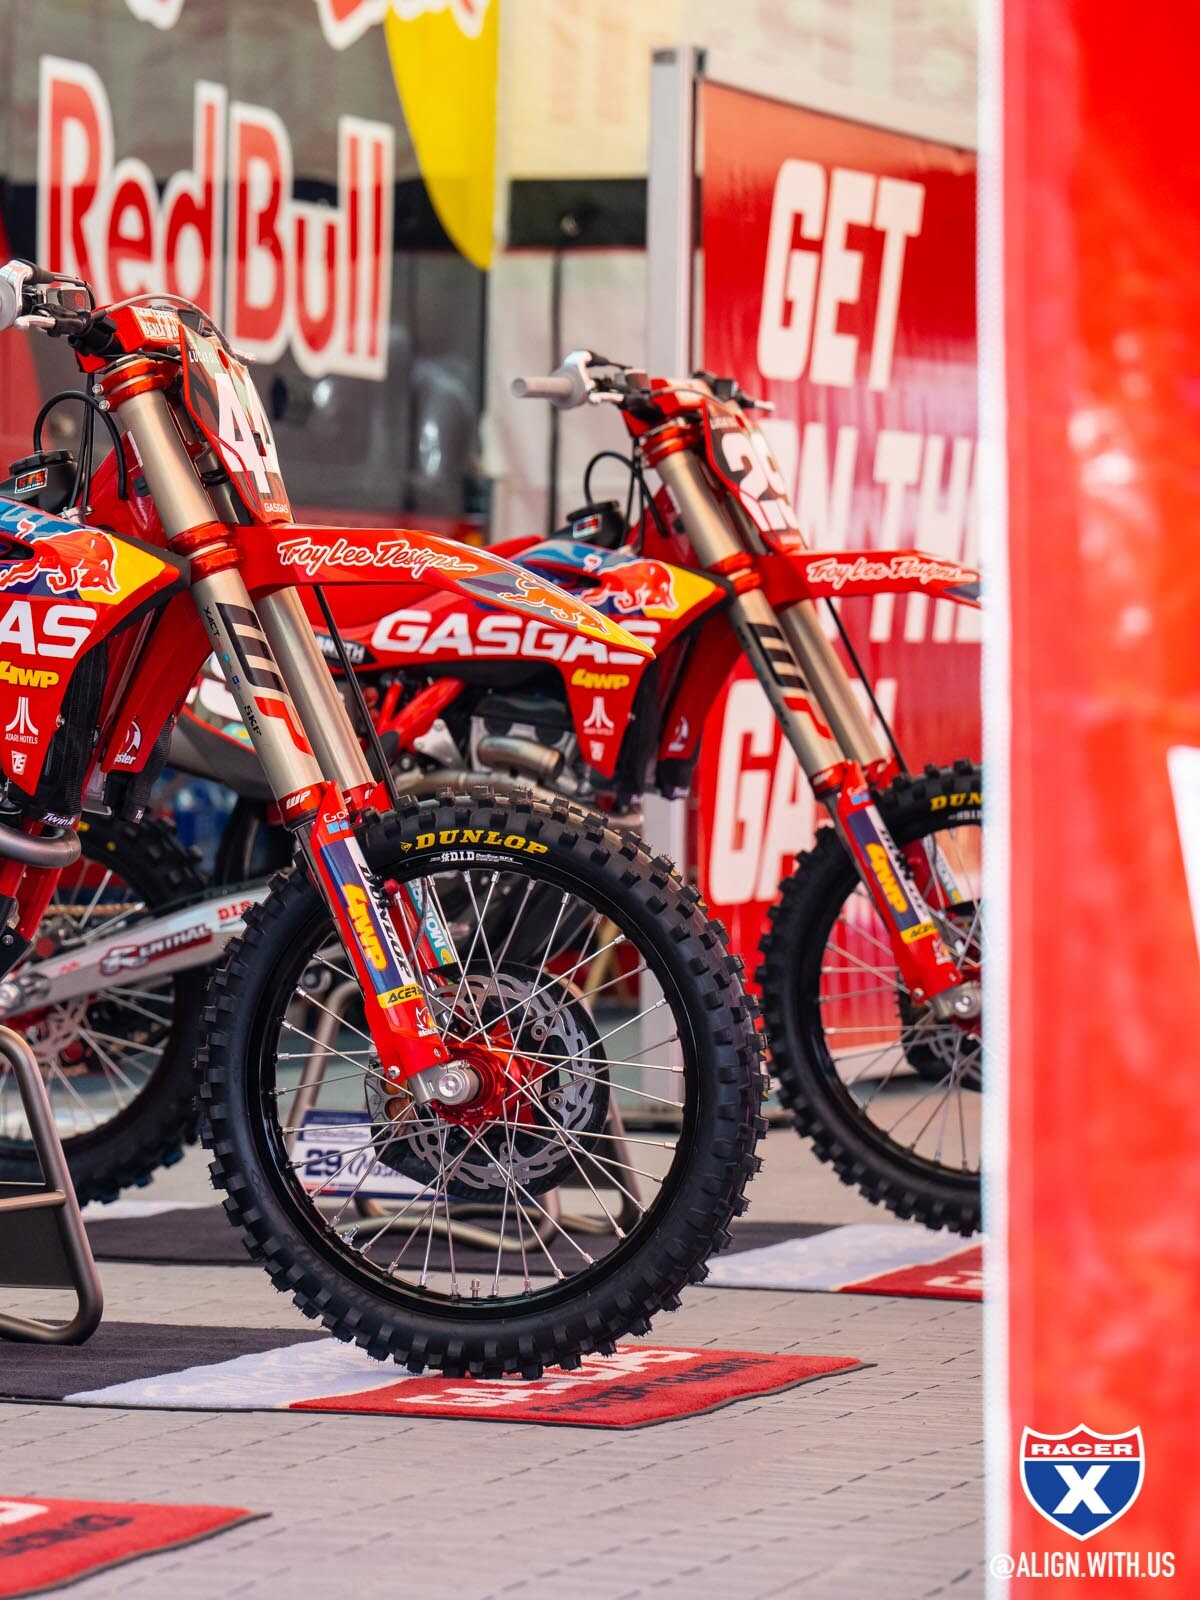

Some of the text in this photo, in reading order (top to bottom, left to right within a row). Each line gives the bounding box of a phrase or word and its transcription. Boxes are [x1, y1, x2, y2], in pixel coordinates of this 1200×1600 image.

[757, 158, 925, 391] GET
[214, 370, 280, 494] 44
[264, 502, 289, 514] GASGAS
[277, 537, 478, 579] Troy Lee Designs
[806, 557, 853, 590] Troy
[204, 606, 221, 637] XACT
[371, 608, 663, 665] GASGAS
[244, 704, 261, 736] SKF
[5, 733, 39, 745] ATARI HOTELS
[930, 792, 982, 811] DUN
[43, 811, 69, 825] Twin
[415, 829, 549, 854] DUNLOP
[342, 883, 388, 971] 4WP
[305, 1149, 342, 1177] 29
